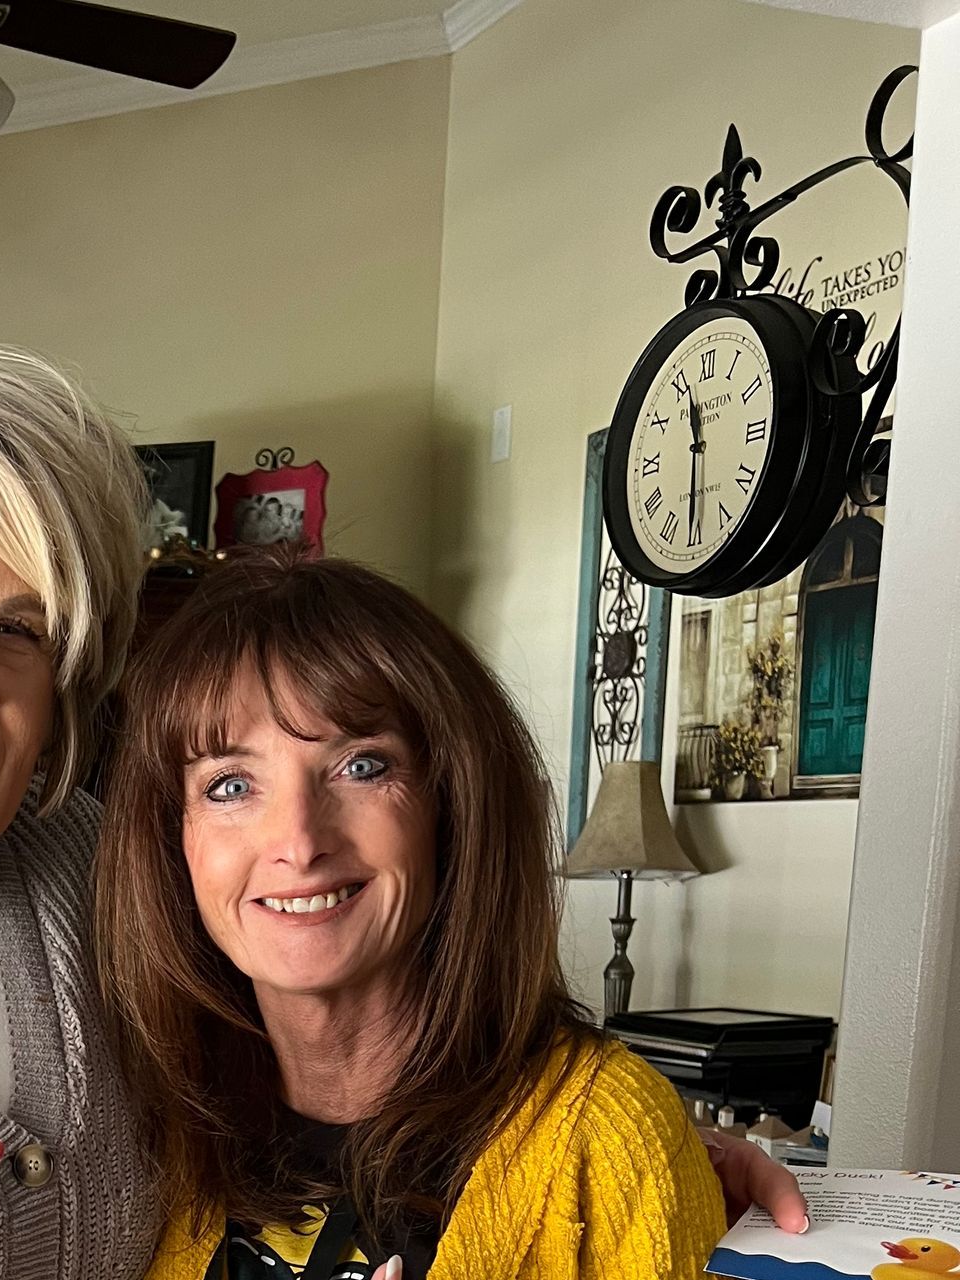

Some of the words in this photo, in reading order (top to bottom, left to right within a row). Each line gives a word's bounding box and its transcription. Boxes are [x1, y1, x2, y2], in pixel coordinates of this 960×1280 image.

[821, 262, 872, 298] TAKES
[877, 247, 906, 276] YO
[821, 275, 899, 313] UNEXPECTED
[699, 349, 716, 382] XII
[671, 368, 690, 403] XI
[741, 374, 762, 405] II
[680, 392, 732, 421] PADINGTON
[650, 410, 670, 435] X
[745, 417, 767, 445] III
[642, 452, 661, 478] IX
[735, 462, 757, 495] IV
[680, 488, 704, 502] LONON
[719, 501, 733, 530] V
[834, 1172, 883, 1180] Duck!
